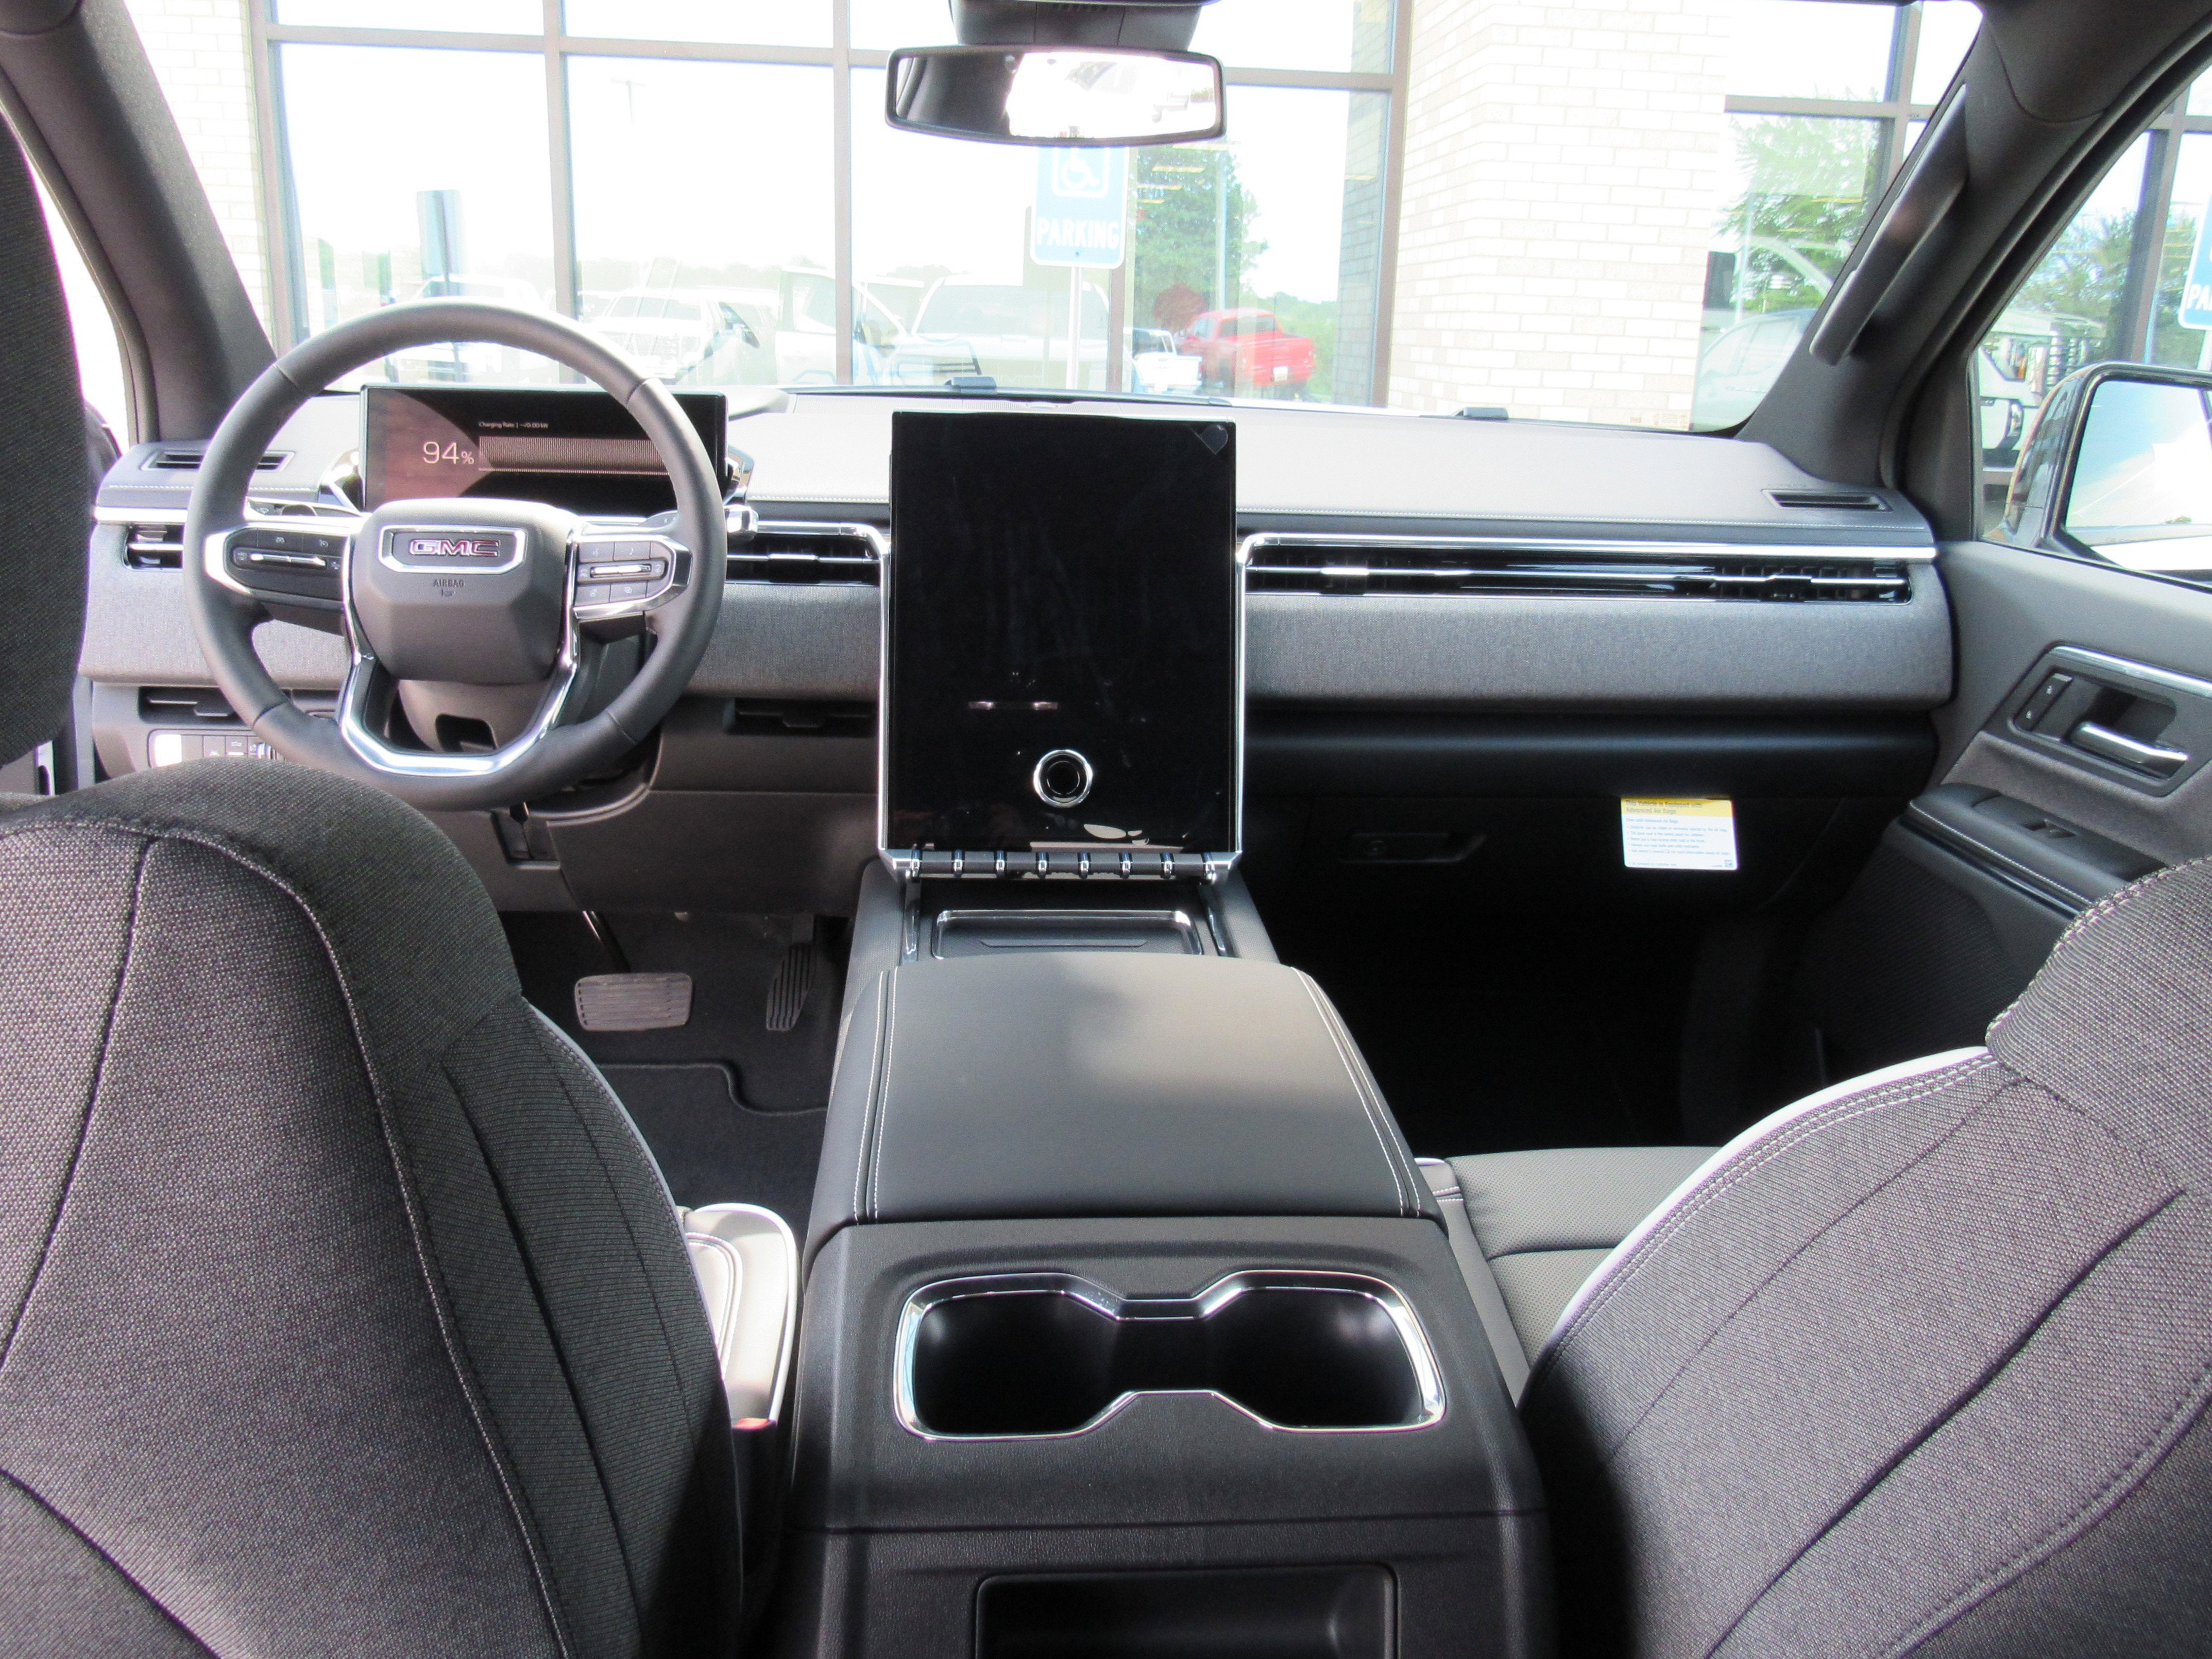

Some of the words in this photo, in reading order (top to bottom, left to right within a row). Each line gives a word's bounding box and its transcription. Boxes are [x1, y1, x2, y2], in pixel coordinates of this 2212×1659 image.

[1036, 217, 1120, 250] PARKING
[2186, 284, 2212, 311] PA
[410, 539, 499, 557] GMC
[433, 579, 464, 588] AIRBAG
